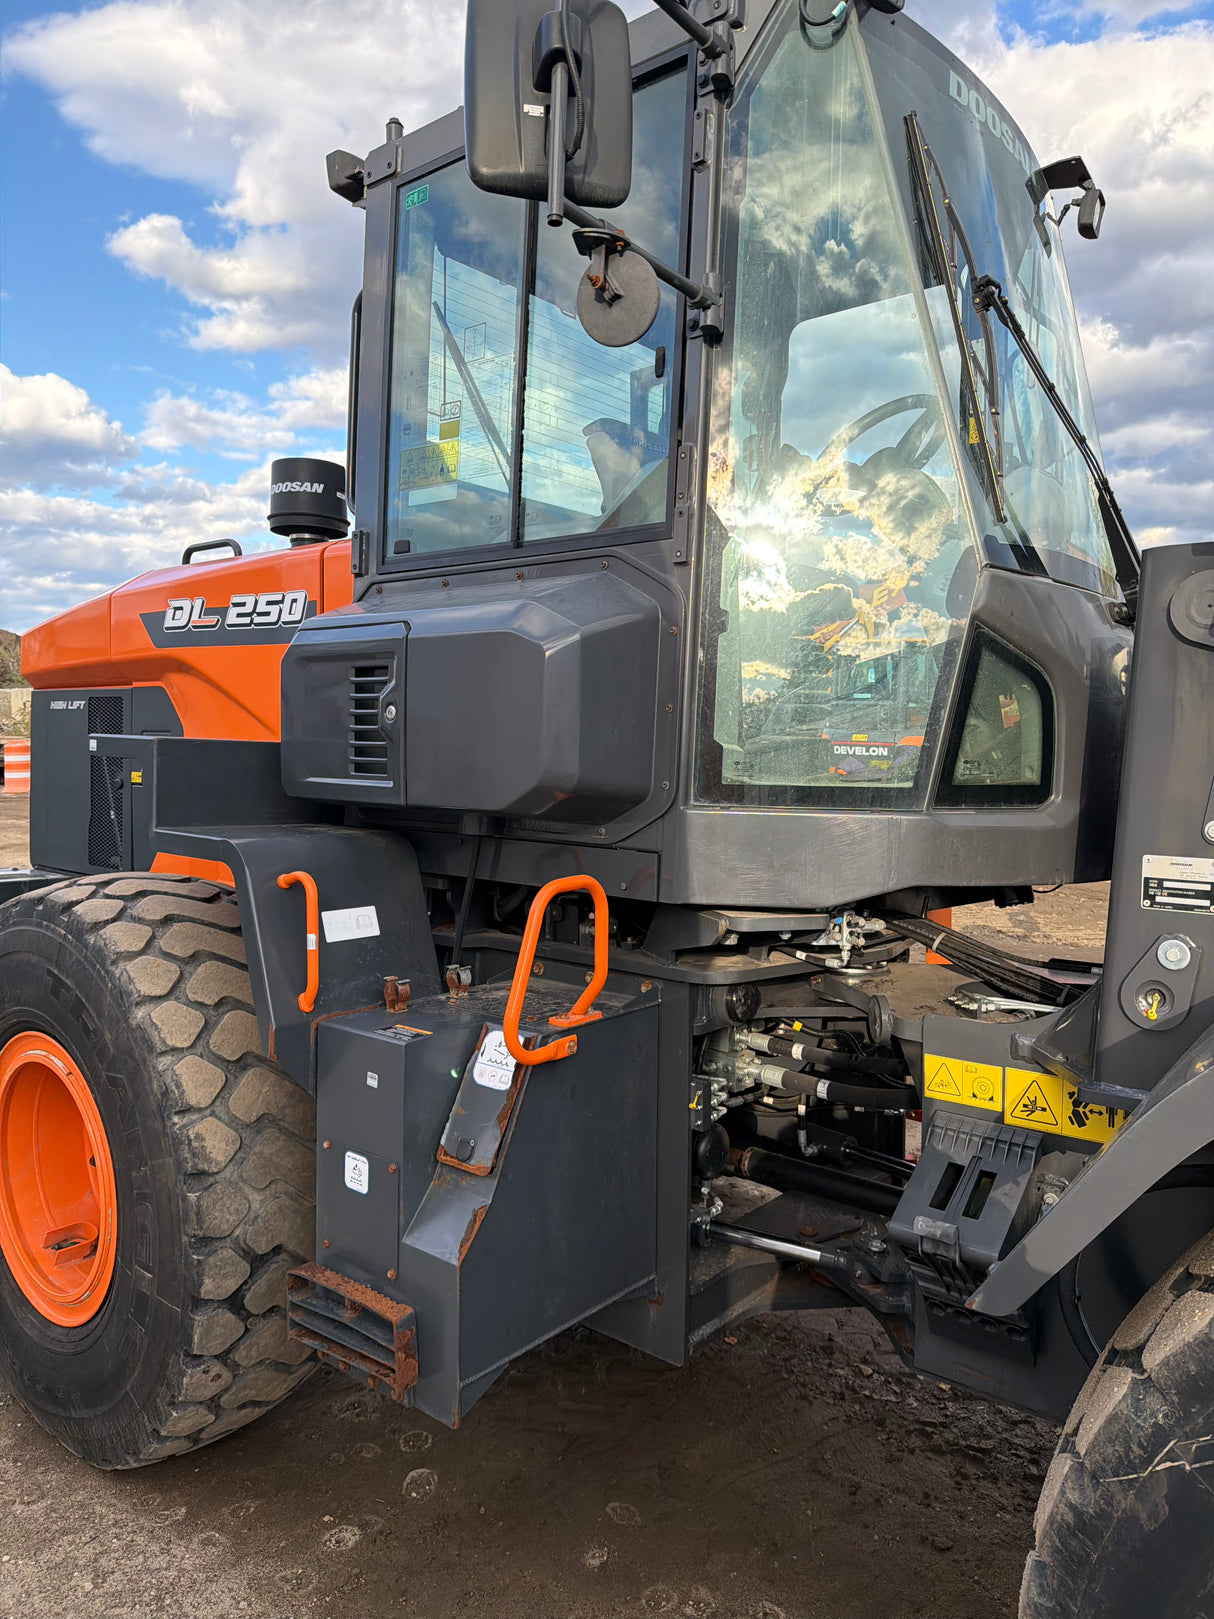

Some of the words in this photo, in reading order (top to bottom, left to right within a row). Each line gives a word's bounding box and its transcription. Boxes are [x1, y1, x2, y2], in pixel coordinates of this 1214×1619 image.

[163, 597, 221, 633] DL
[224, 590, 308, 630] 250
[50, 700, 67, 710] HIGH
[67, 700, 86, 710] LIFT
[833, 745, 888, 756] DEVELON
